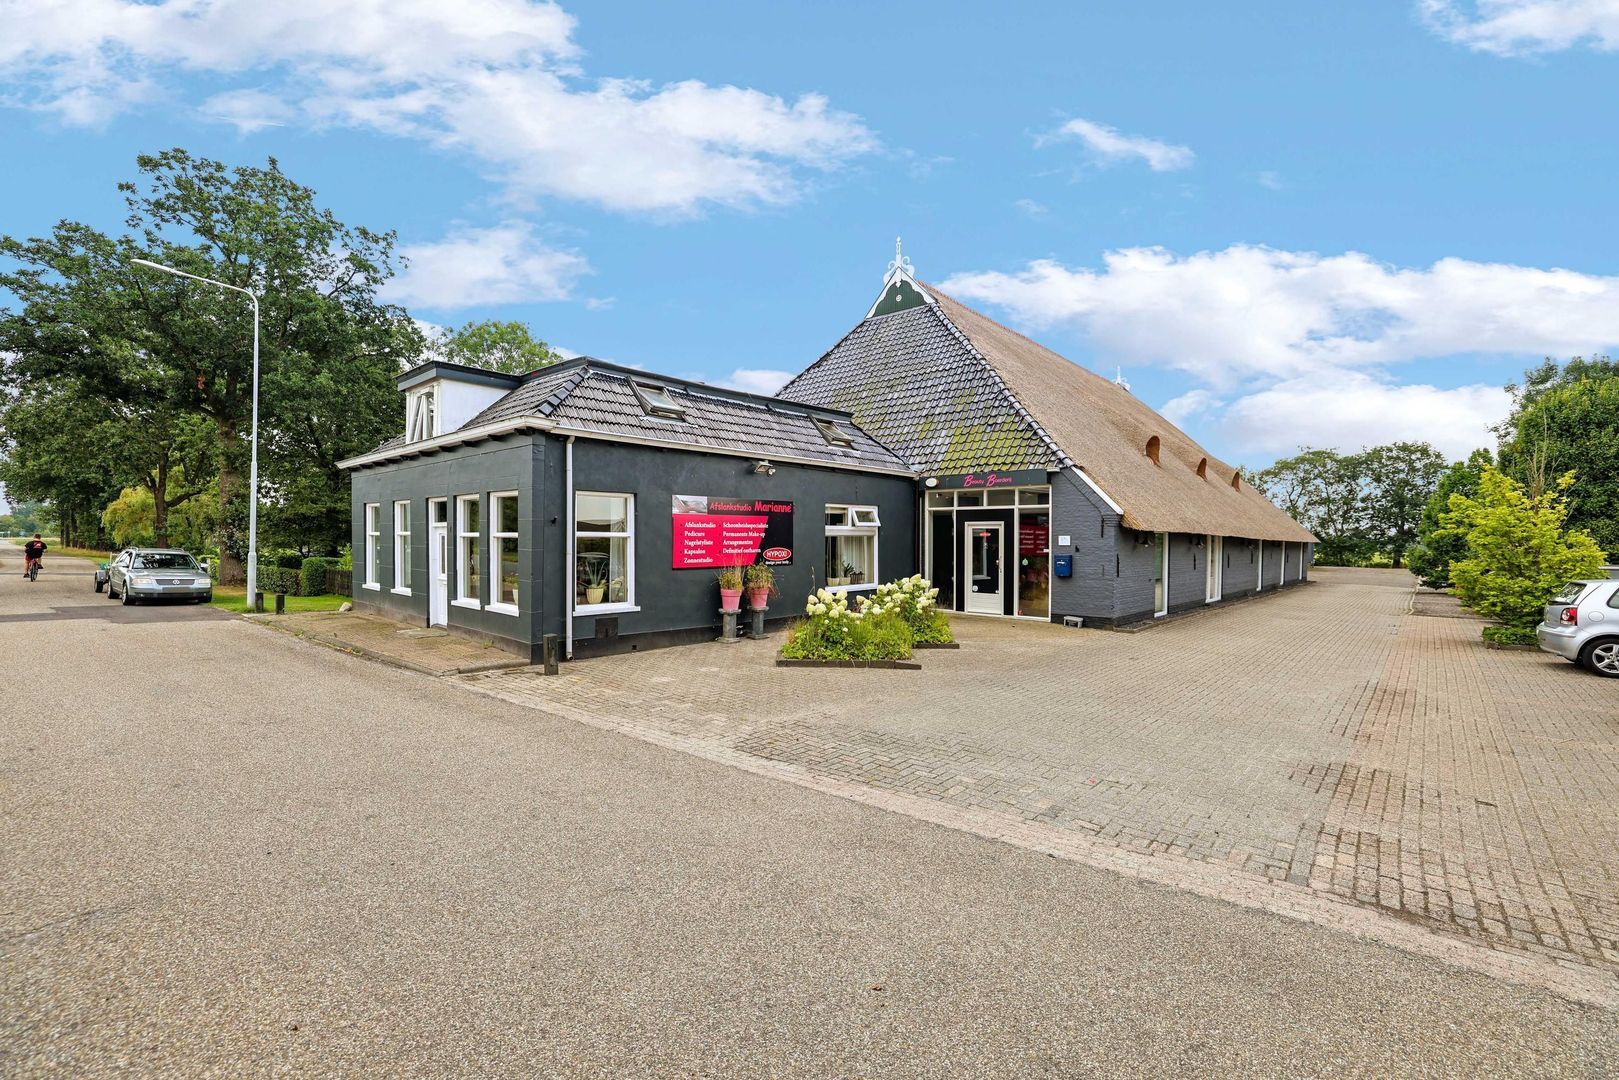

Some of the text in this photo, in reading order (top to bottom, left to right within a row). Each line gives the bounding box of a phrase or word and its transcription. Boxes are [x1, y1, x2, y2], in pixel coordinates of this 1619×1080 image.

[963, 474, 984, 487] Beauty
[709, 501, 792, 513] Afslankstudio Marianne
